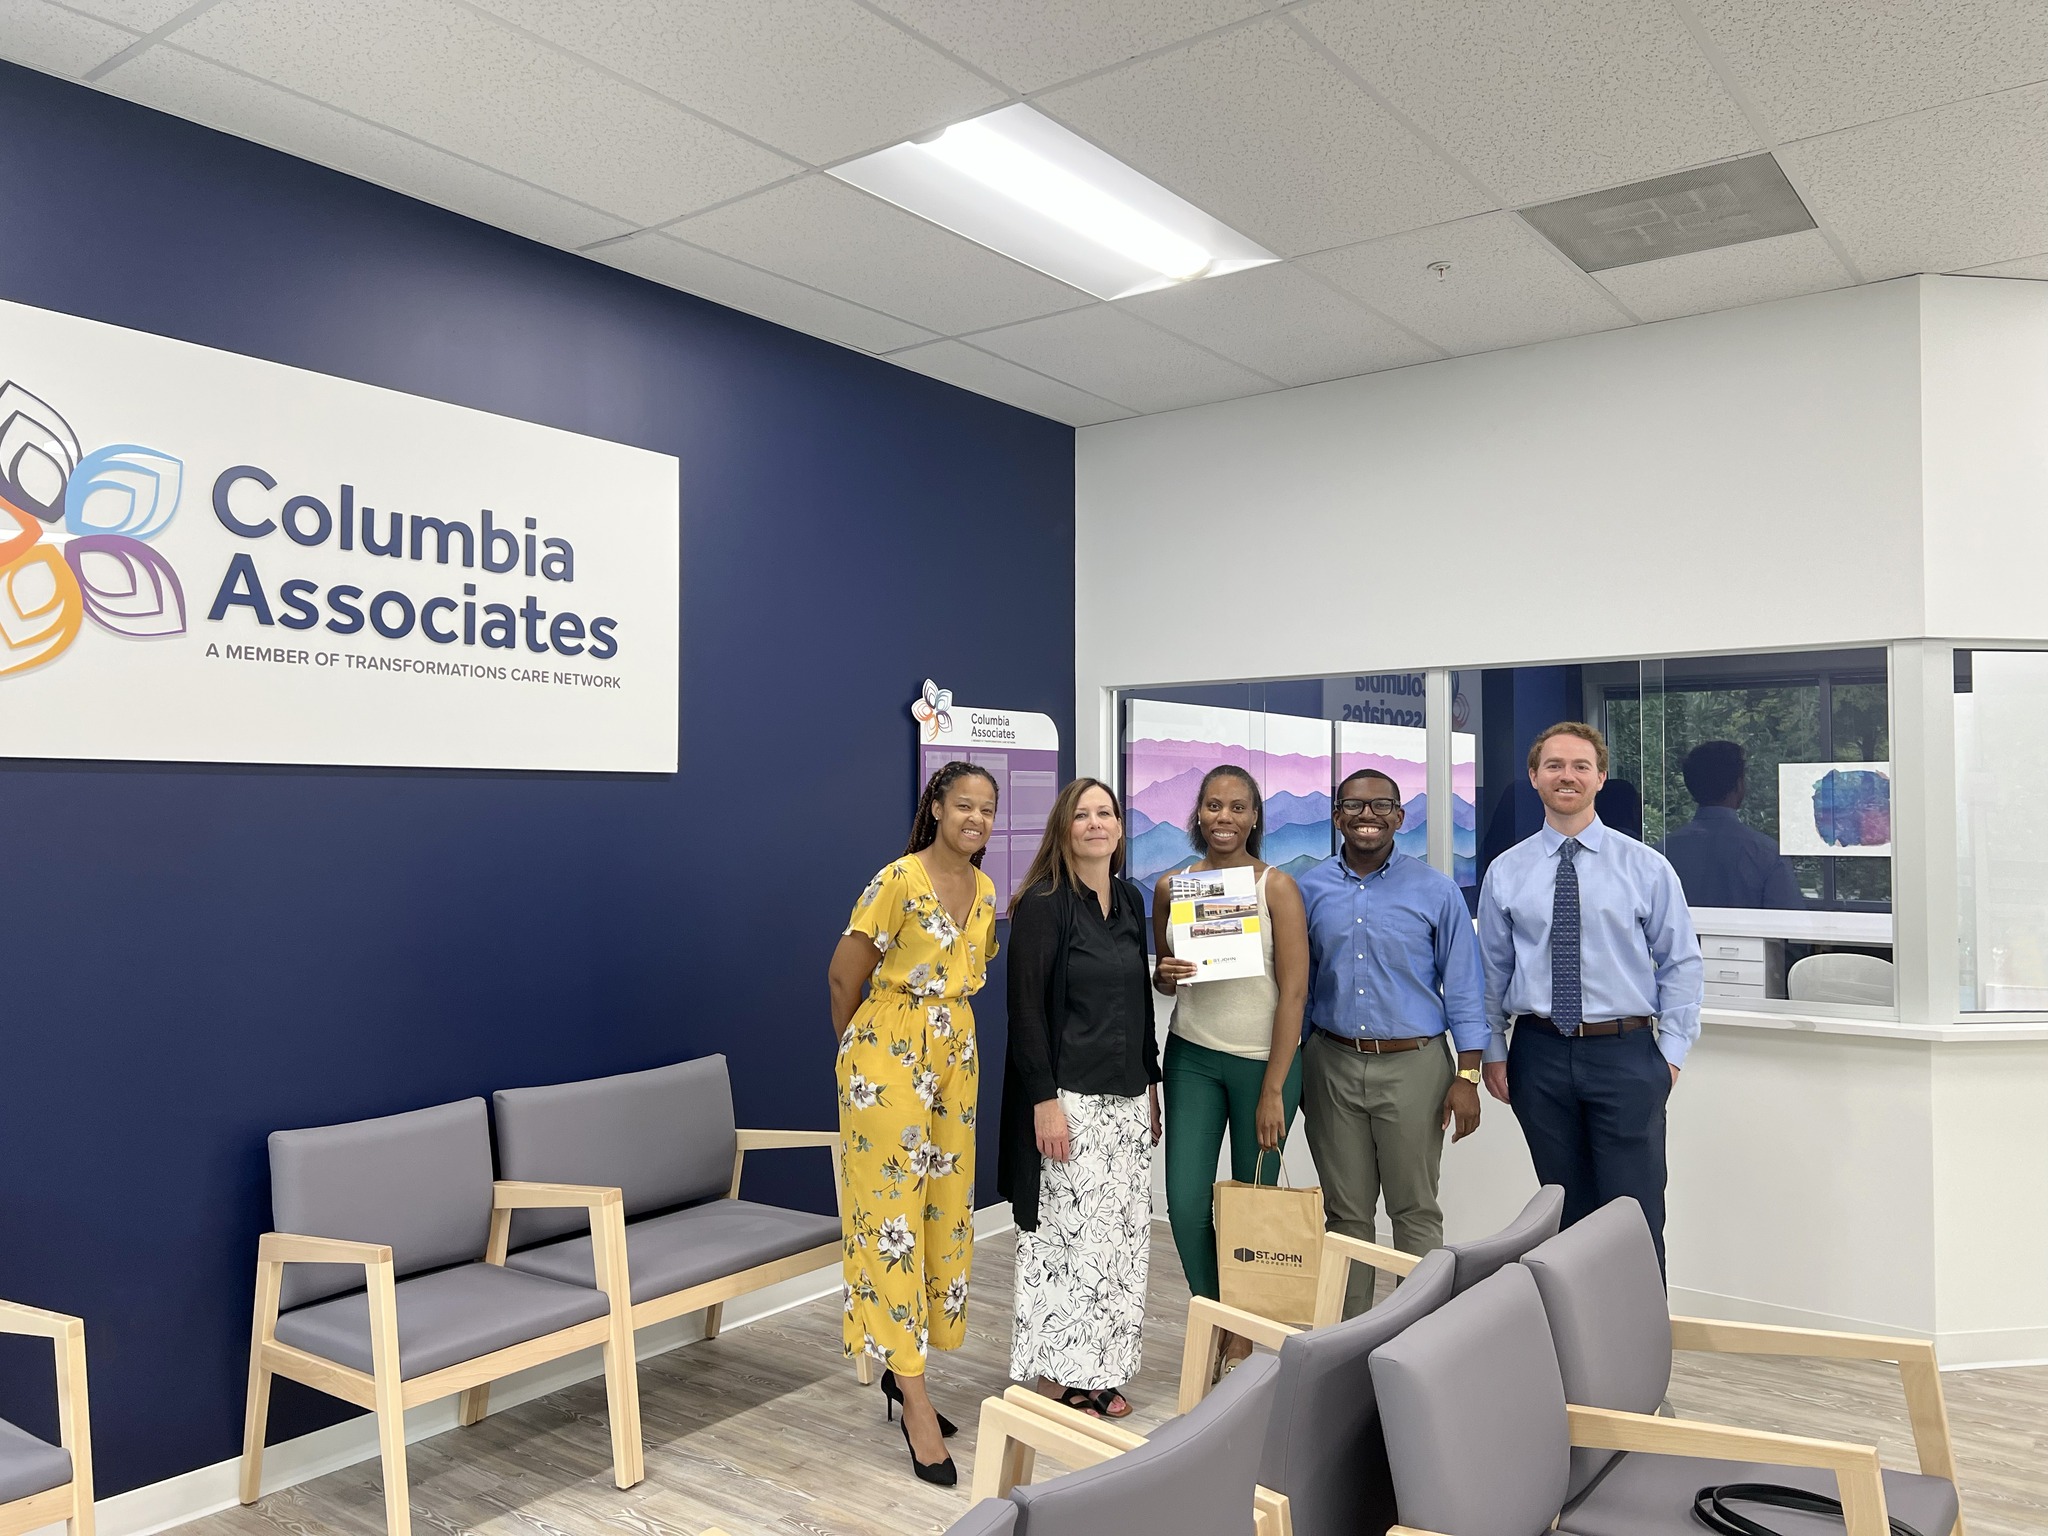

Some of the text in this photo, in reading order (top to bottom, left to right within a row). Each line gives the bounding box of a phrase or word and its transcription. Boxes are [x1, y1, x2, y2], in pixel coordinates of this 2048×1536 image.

[211, 464, 575, 583] Columbia
[206, 552, 619, 660] Associates
[205, 642, 621, 689] A MEMBER OF TRANSFORMATIONS CARE NETWORK
[971, 712, 1010, 726] Columbia
[971, 725, 1016, 739] Associates
[1255, 1259, 1303, 1268] PROPERTIES
